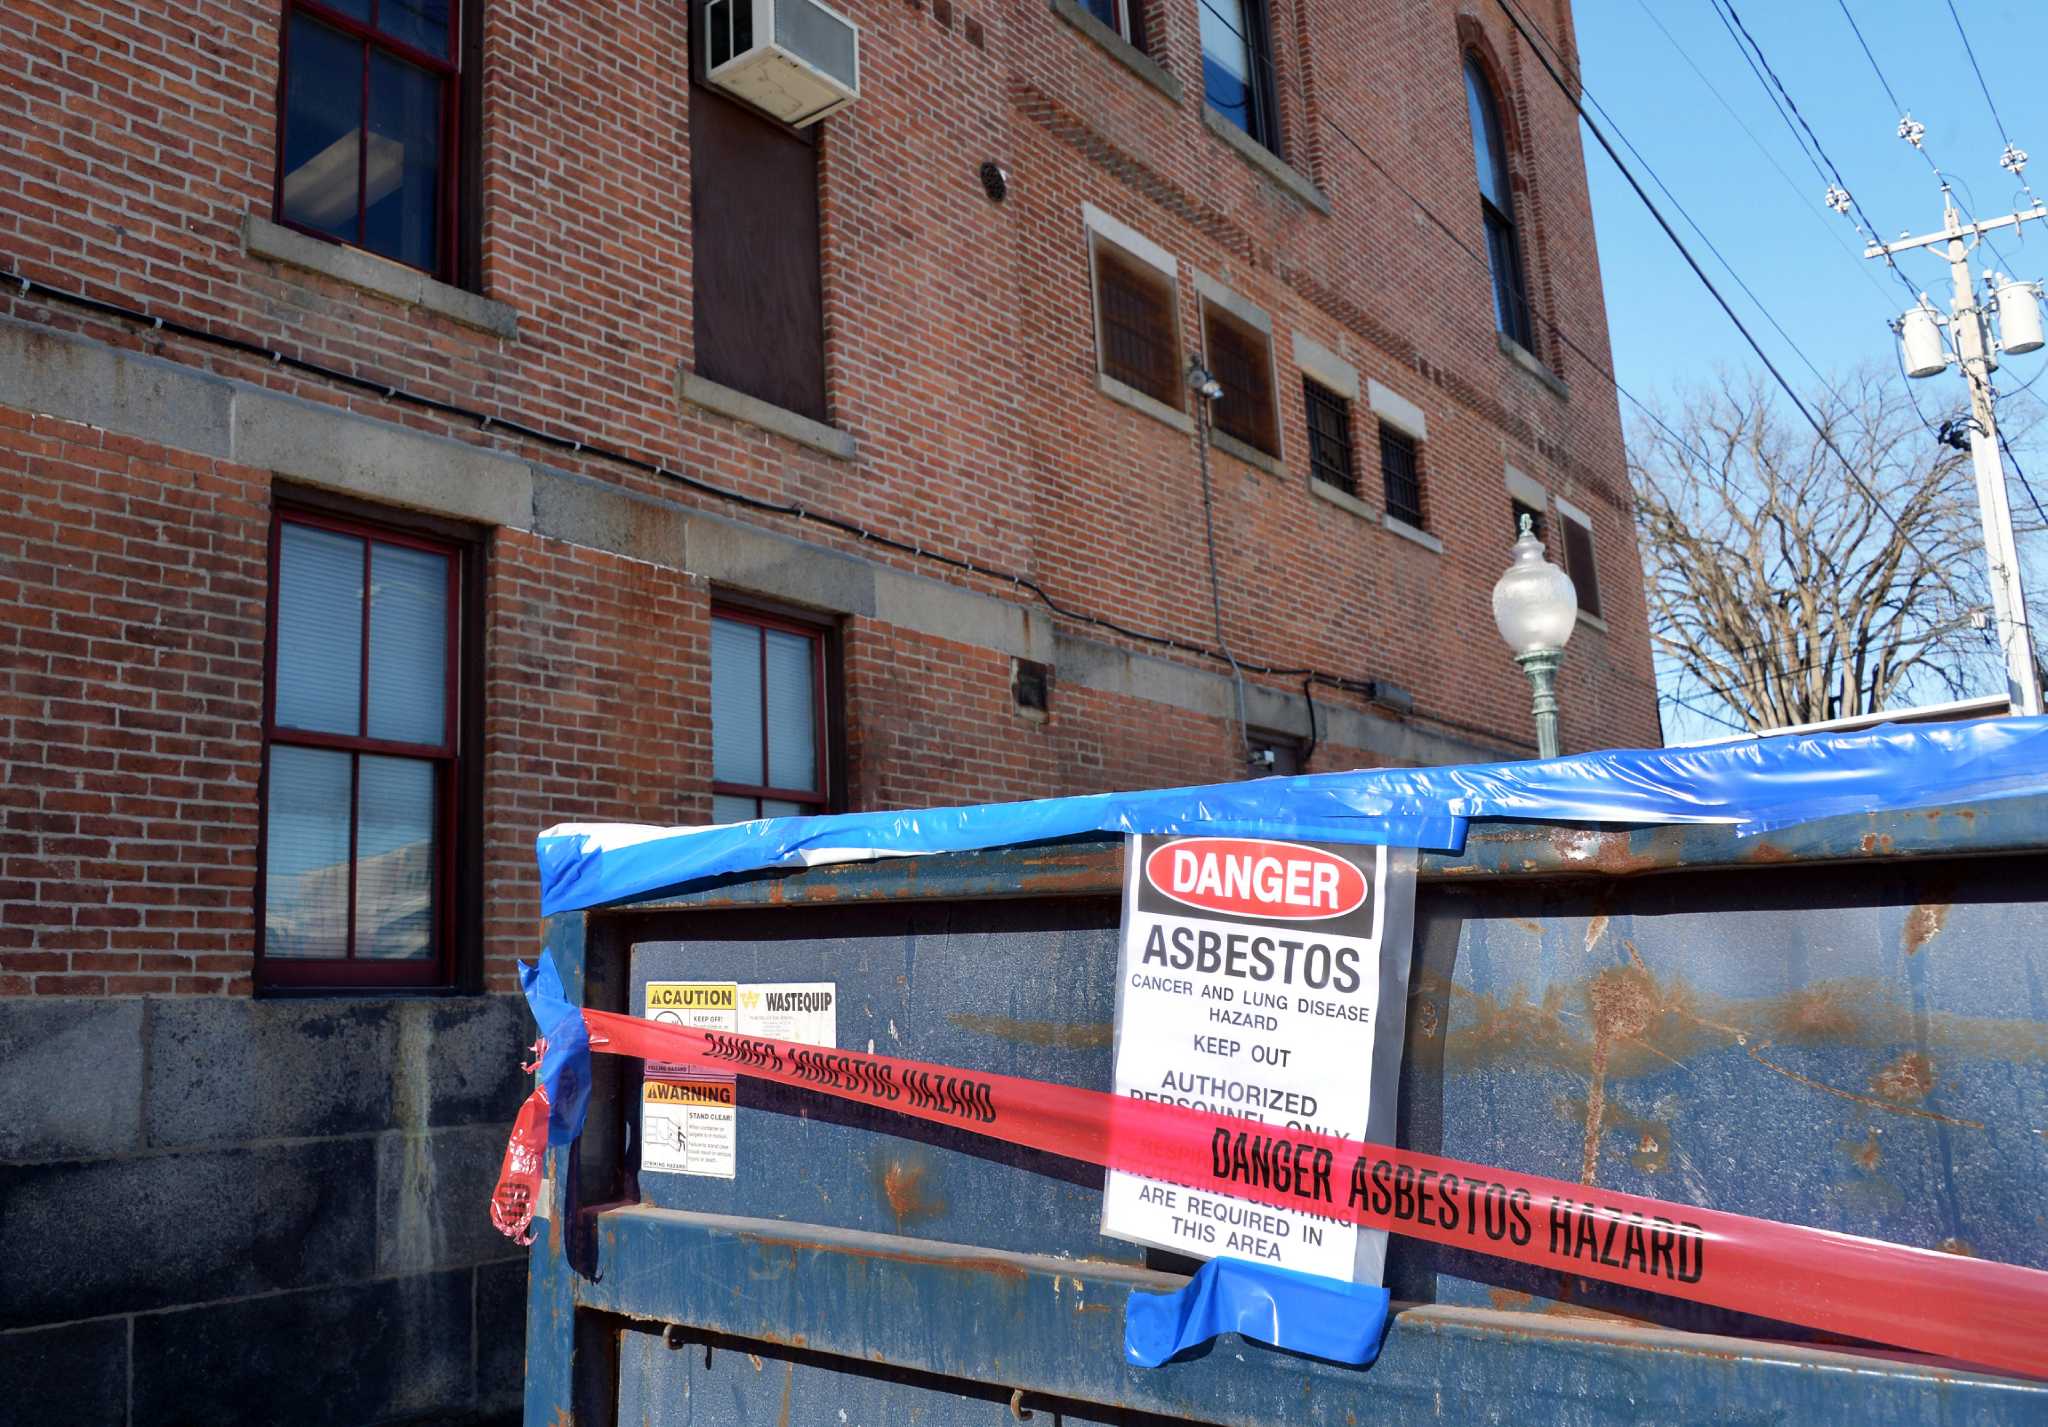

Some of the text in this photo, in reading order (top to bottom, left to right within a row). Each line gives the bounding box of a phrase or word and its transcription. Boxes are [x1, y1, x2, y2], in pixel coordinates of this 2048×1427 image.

[1173, 849, 1339, 909] DANGER
[1142, 925, 1360, 993] ASBESTOS
[663, 990, 732, 1005] CAUTION
[766, 992, 832, 1012] WASTEQUIP
[1131, 974, 1369, 1023] CANCER AND LUNG DISEASE
[1210, 1008, 1278, 1031] HAZARD
[1194, 1034, 1291, 1067] KEEP OUT
[657, 1085, 730, 1103] WARNING
[1161, 1070, 1318, 1117] AUTHORIZED
[1139, 1185, 1323, 1247] ARE REQUIRED IN
[1212, 1127, 1704, 1284] DANGER ASBESTOS HAZARD
[1171, 1216, 1281, 1262] THIS AREA
